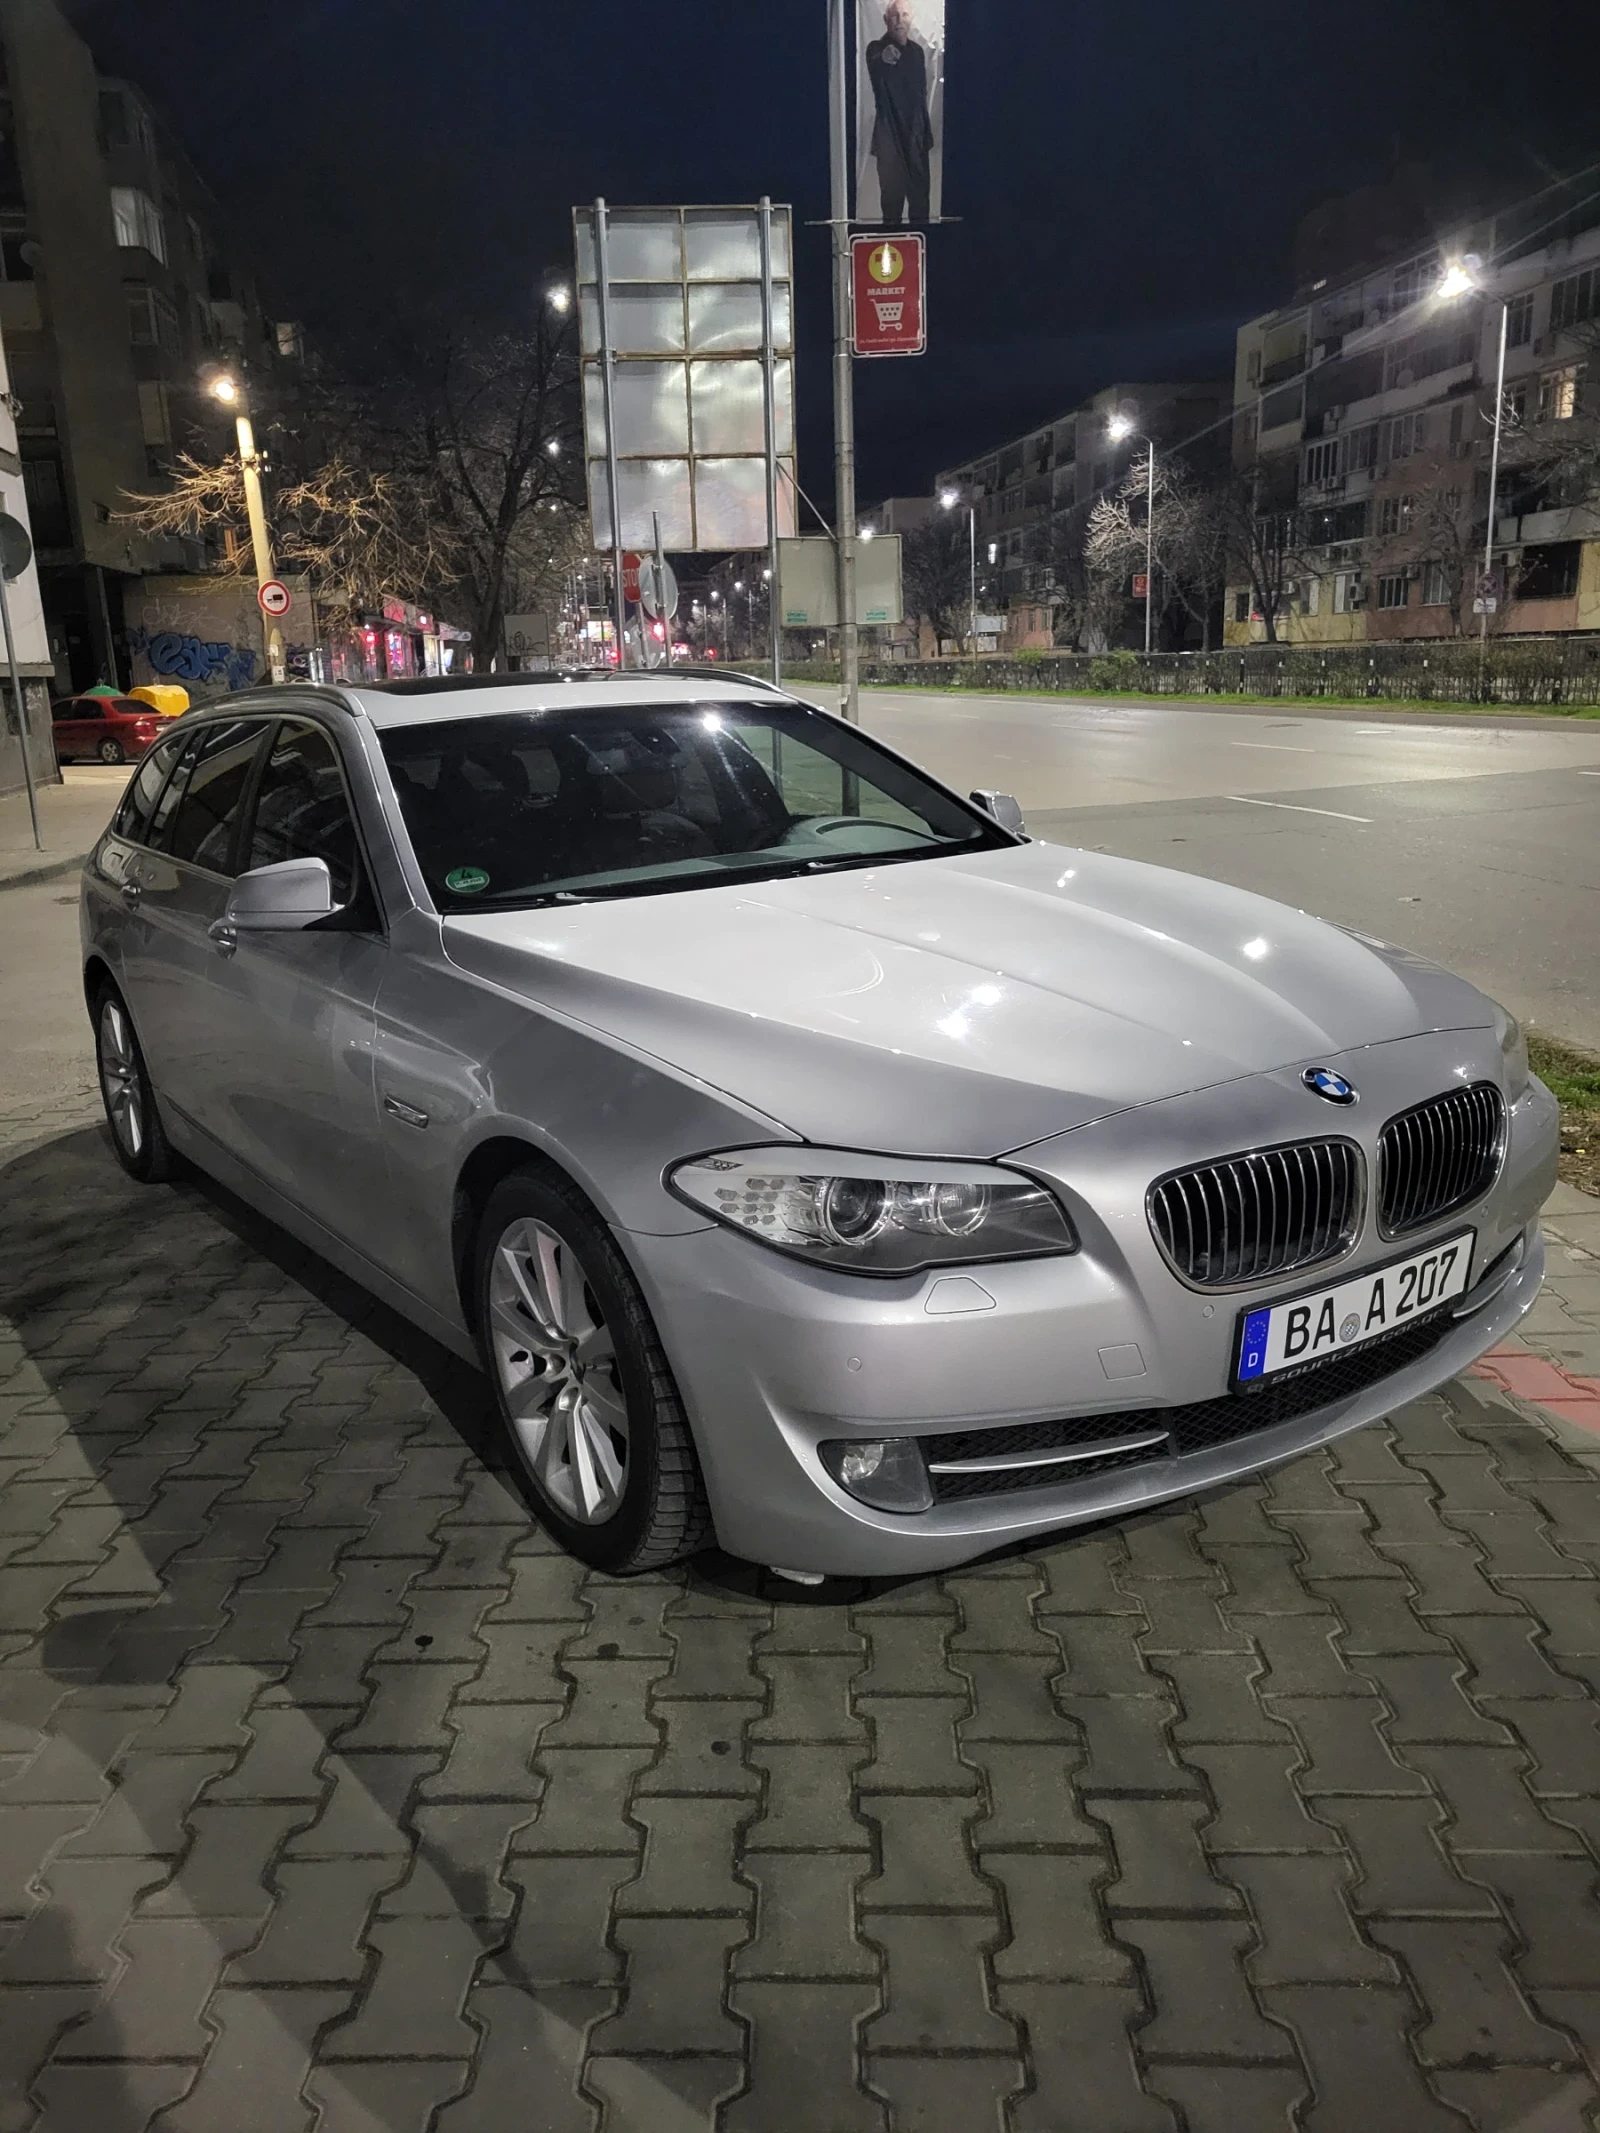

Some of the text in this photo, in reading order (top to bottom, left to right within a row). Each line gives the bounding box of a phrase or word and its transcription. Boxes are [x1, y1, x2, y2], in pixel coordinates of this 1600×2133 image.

[867, 287, 905, 296] MARKET
[622, 569, 639, 587] STO
[461, 868, 473, 879] 4
[1283, 1296, 1336, 1359] BA
[1395, 1245, 1459, 1318] 207
[1247, 1352, 1259, 1368] D
